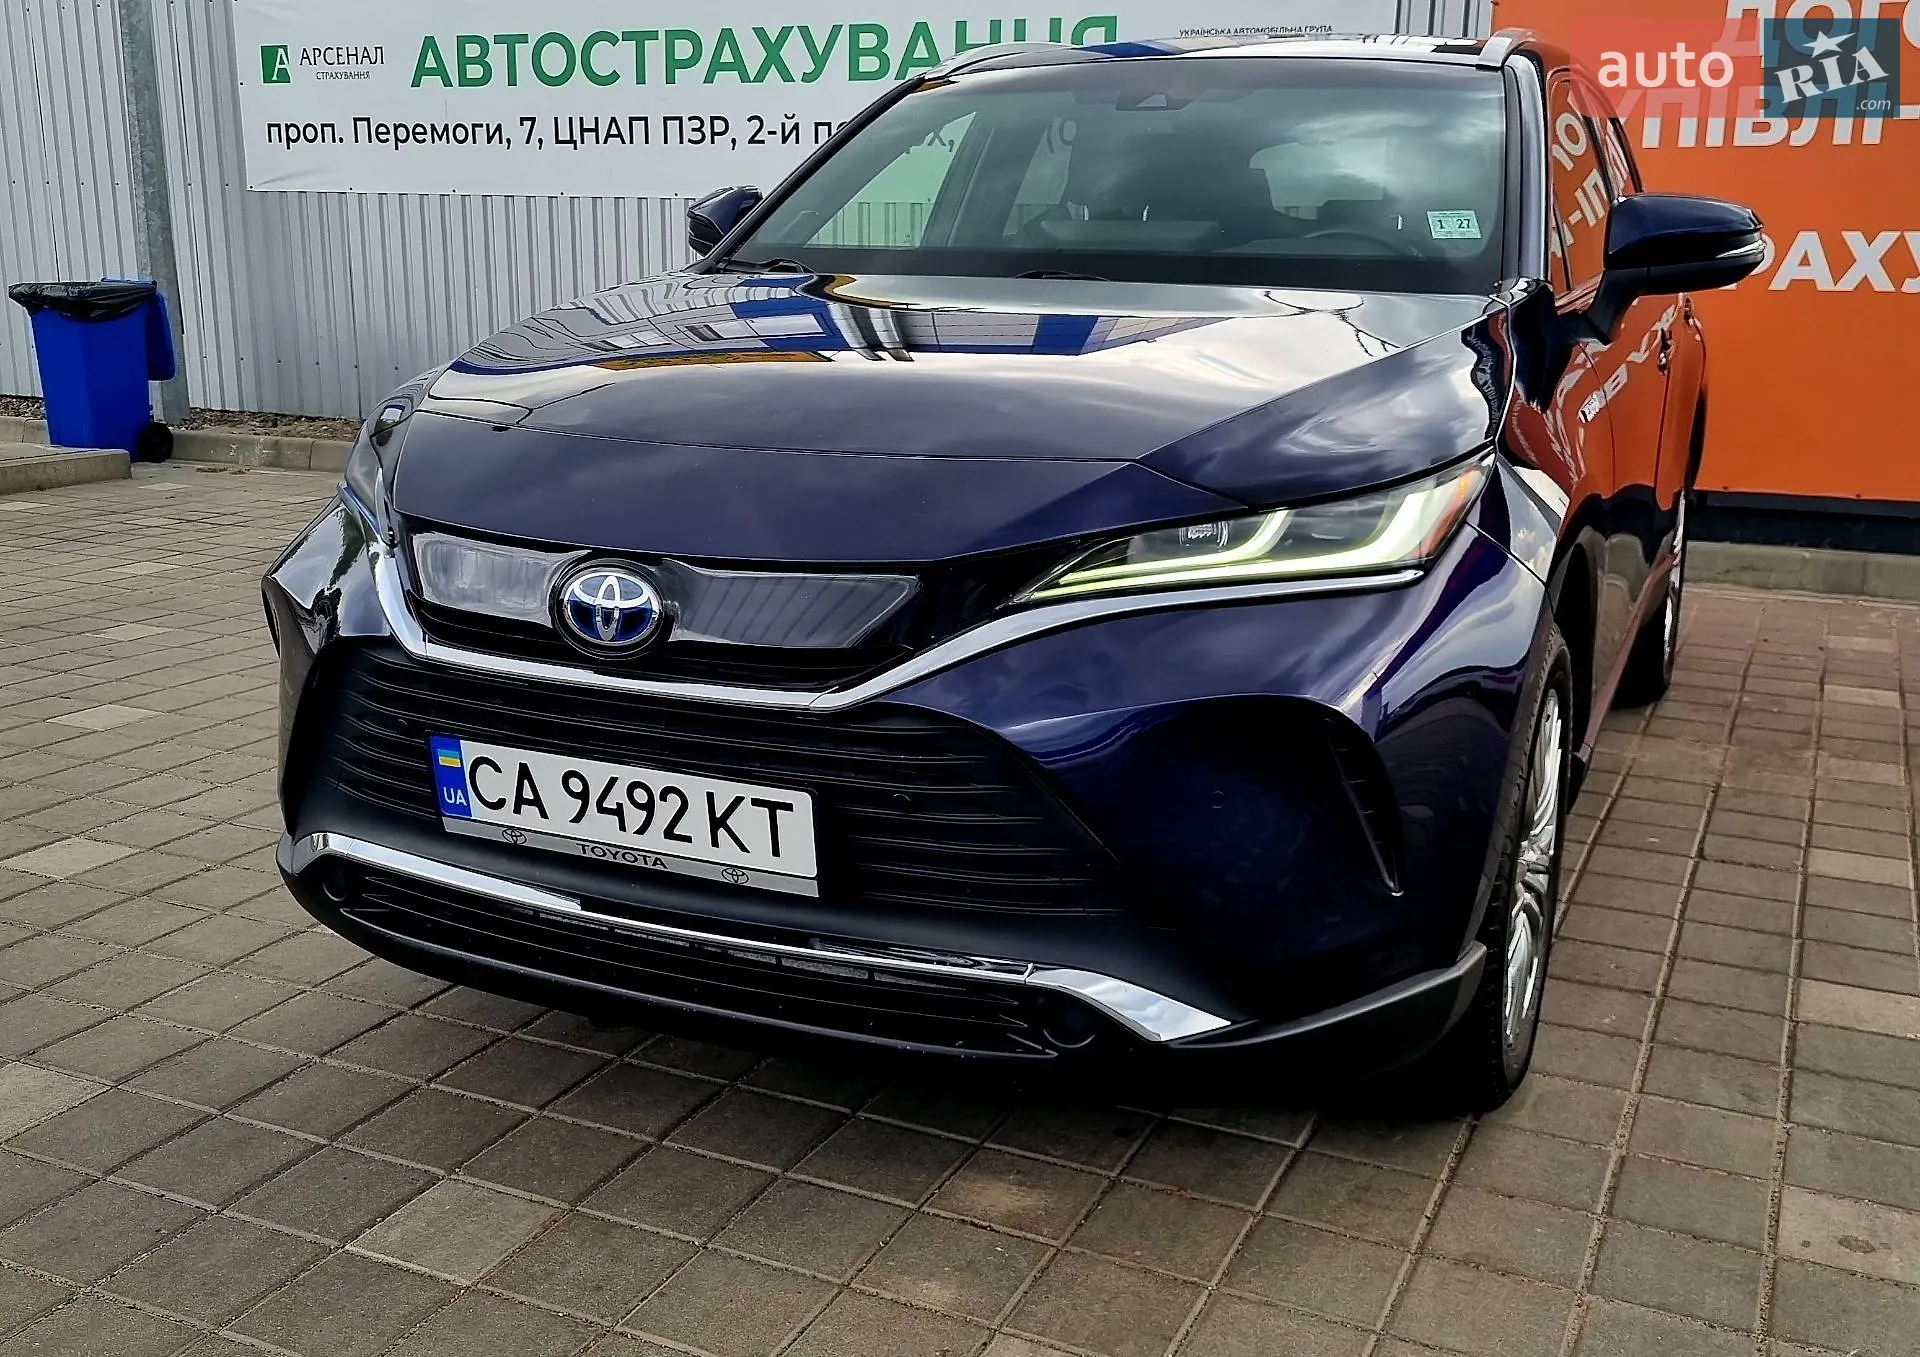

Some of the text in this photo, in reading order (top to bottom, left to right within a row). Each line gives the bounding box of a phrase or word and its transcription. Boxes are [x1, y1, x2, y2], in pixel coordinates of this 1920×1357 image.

[300, 46, 384, 65] АРСЕНАЛ
[316, 71, 370, 80] СТРАХУВАННЯ
[266, 123, 344, 150] проп.
[353, 117, 511, 150] Перемоги,
[519, 116, 543, 150] 7,
[553, 116, 650, 150] ЦНАП
[662, 115, 736, 150] ПЗР,
[747, 113, 800, 145] 2-й
[1456, 218, 1470, 229] 27
[443, 787, 467, 807] UA
[468, 756, 794, 858] CA 9492 KT
[576, 842, 669, 870] TOYOTA
